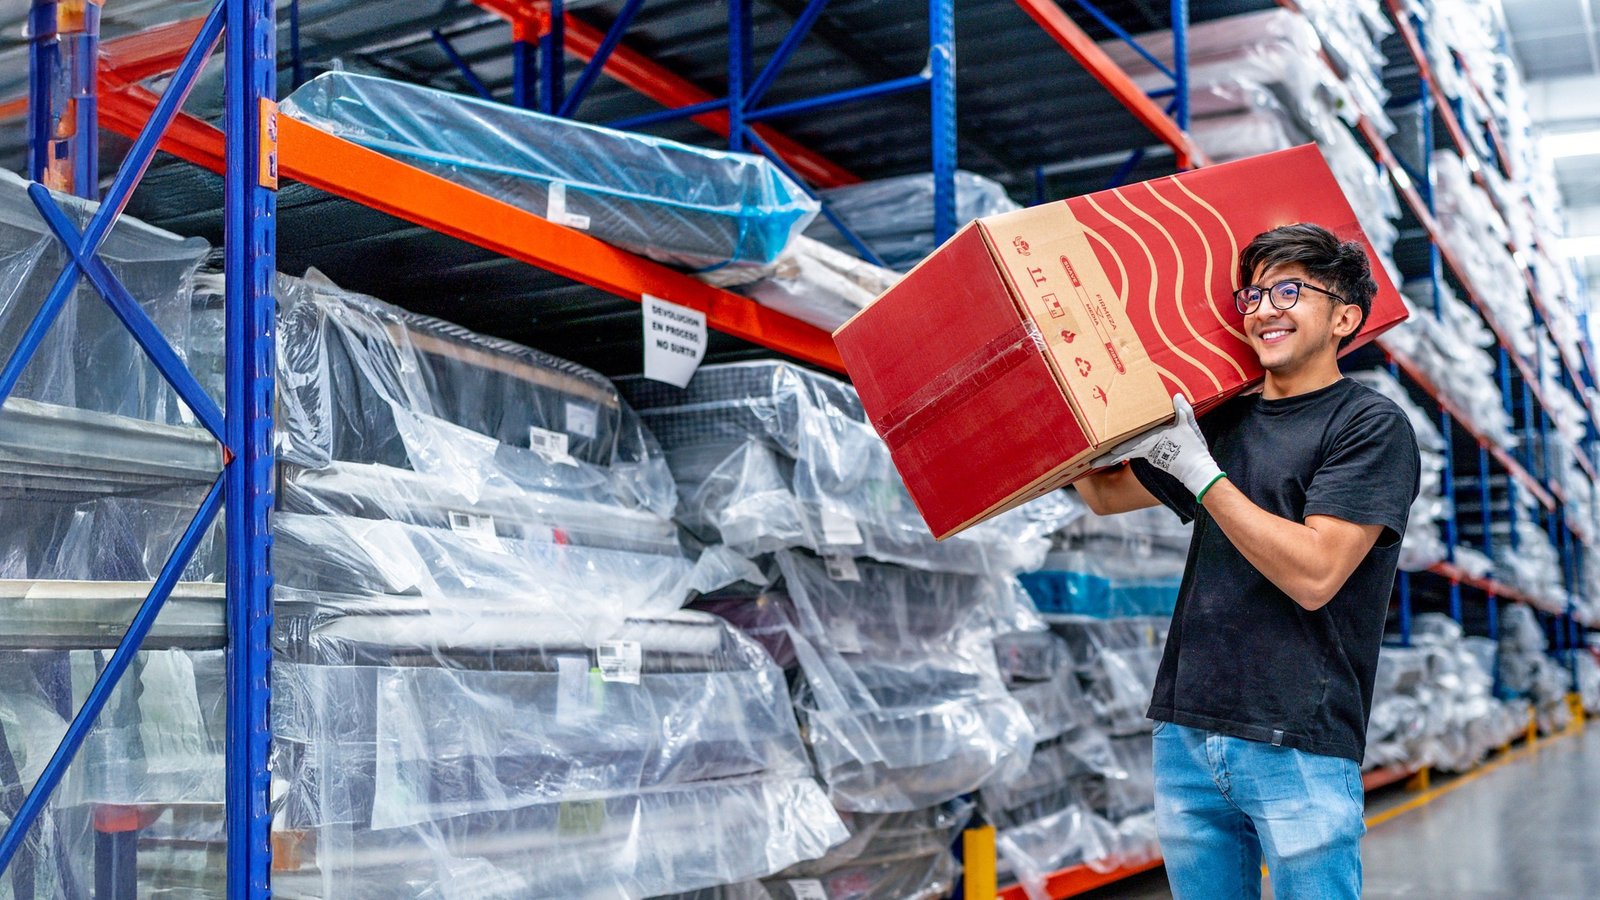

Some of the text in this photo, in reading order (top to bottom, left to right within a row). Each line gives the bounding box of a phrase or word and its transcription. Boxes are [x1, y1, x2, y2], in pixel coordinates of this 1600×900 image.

[1063, 260, 1122, 369] SUAVE MEDIA FIRME
[1096, 294, 1117, 330] FIRMEZA
[652, 321, 663, 331] EN
[656, 339, 697, 358] NO SURTIR
